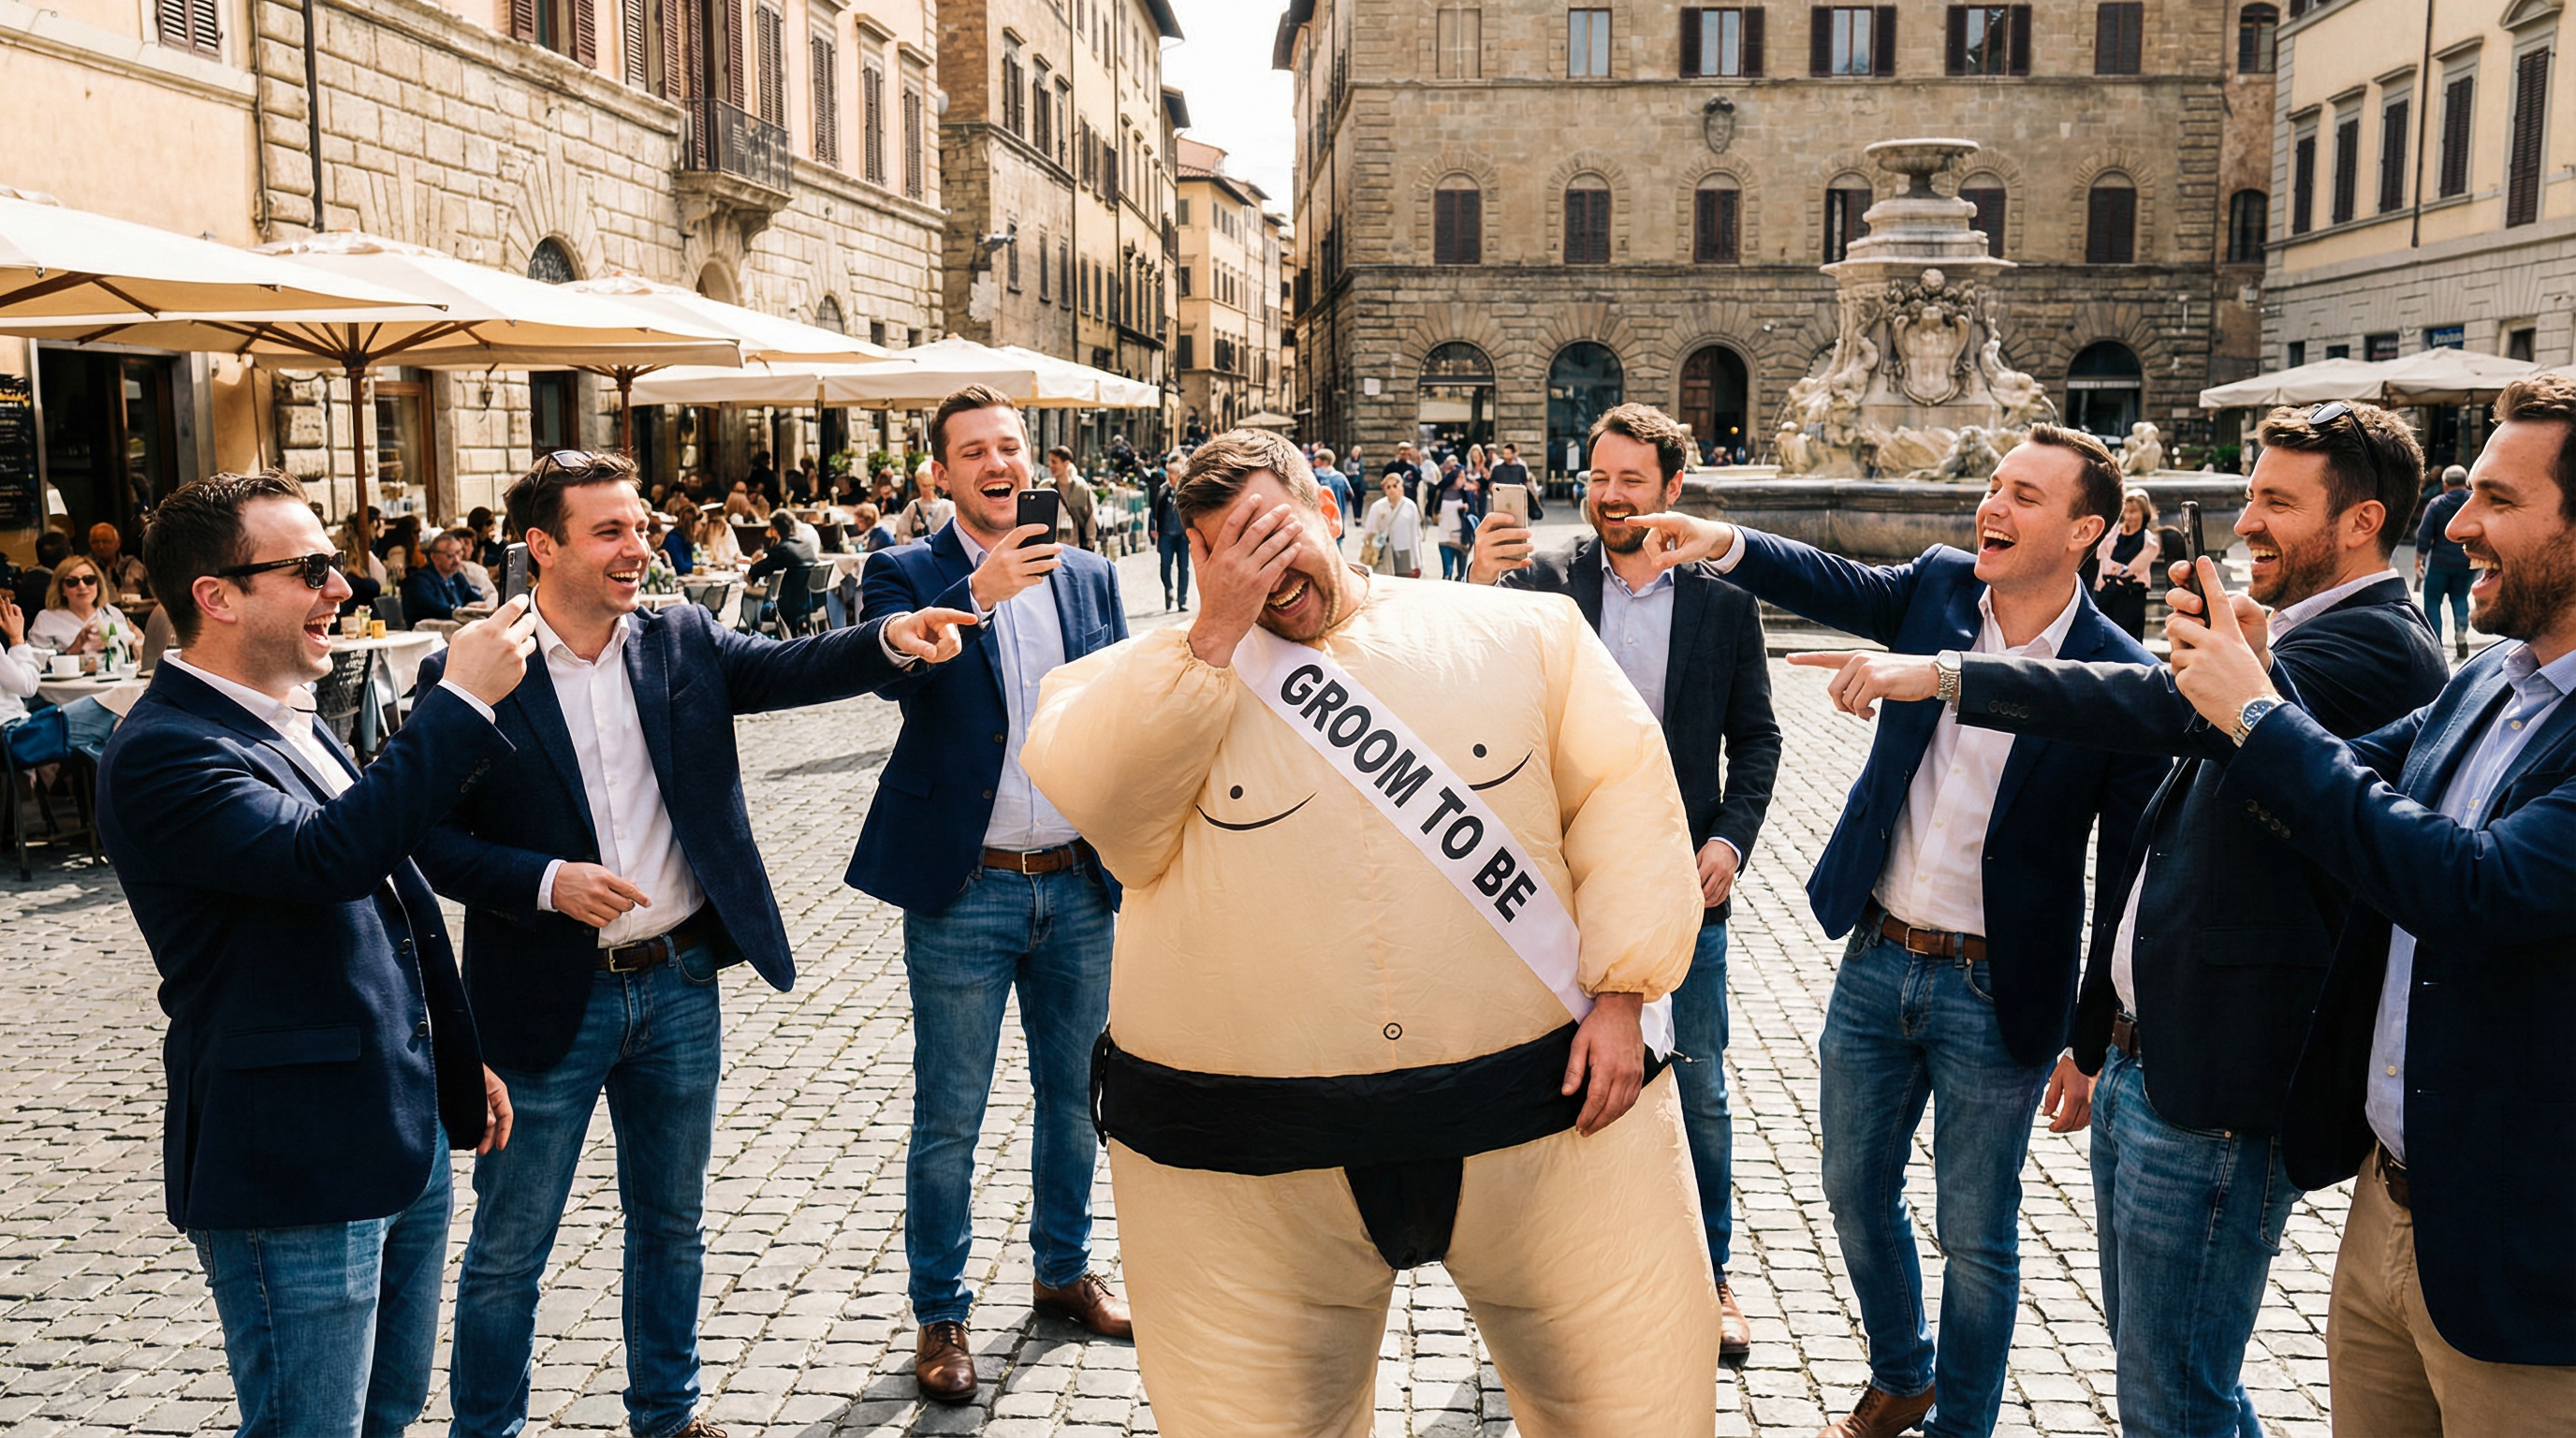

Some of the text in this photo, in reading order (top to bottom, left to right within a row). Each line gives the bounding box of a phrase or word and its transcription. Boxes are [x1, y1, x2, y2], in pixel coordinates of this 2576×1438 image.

[1281, 664, 1538, 924] GROOM TO BE
